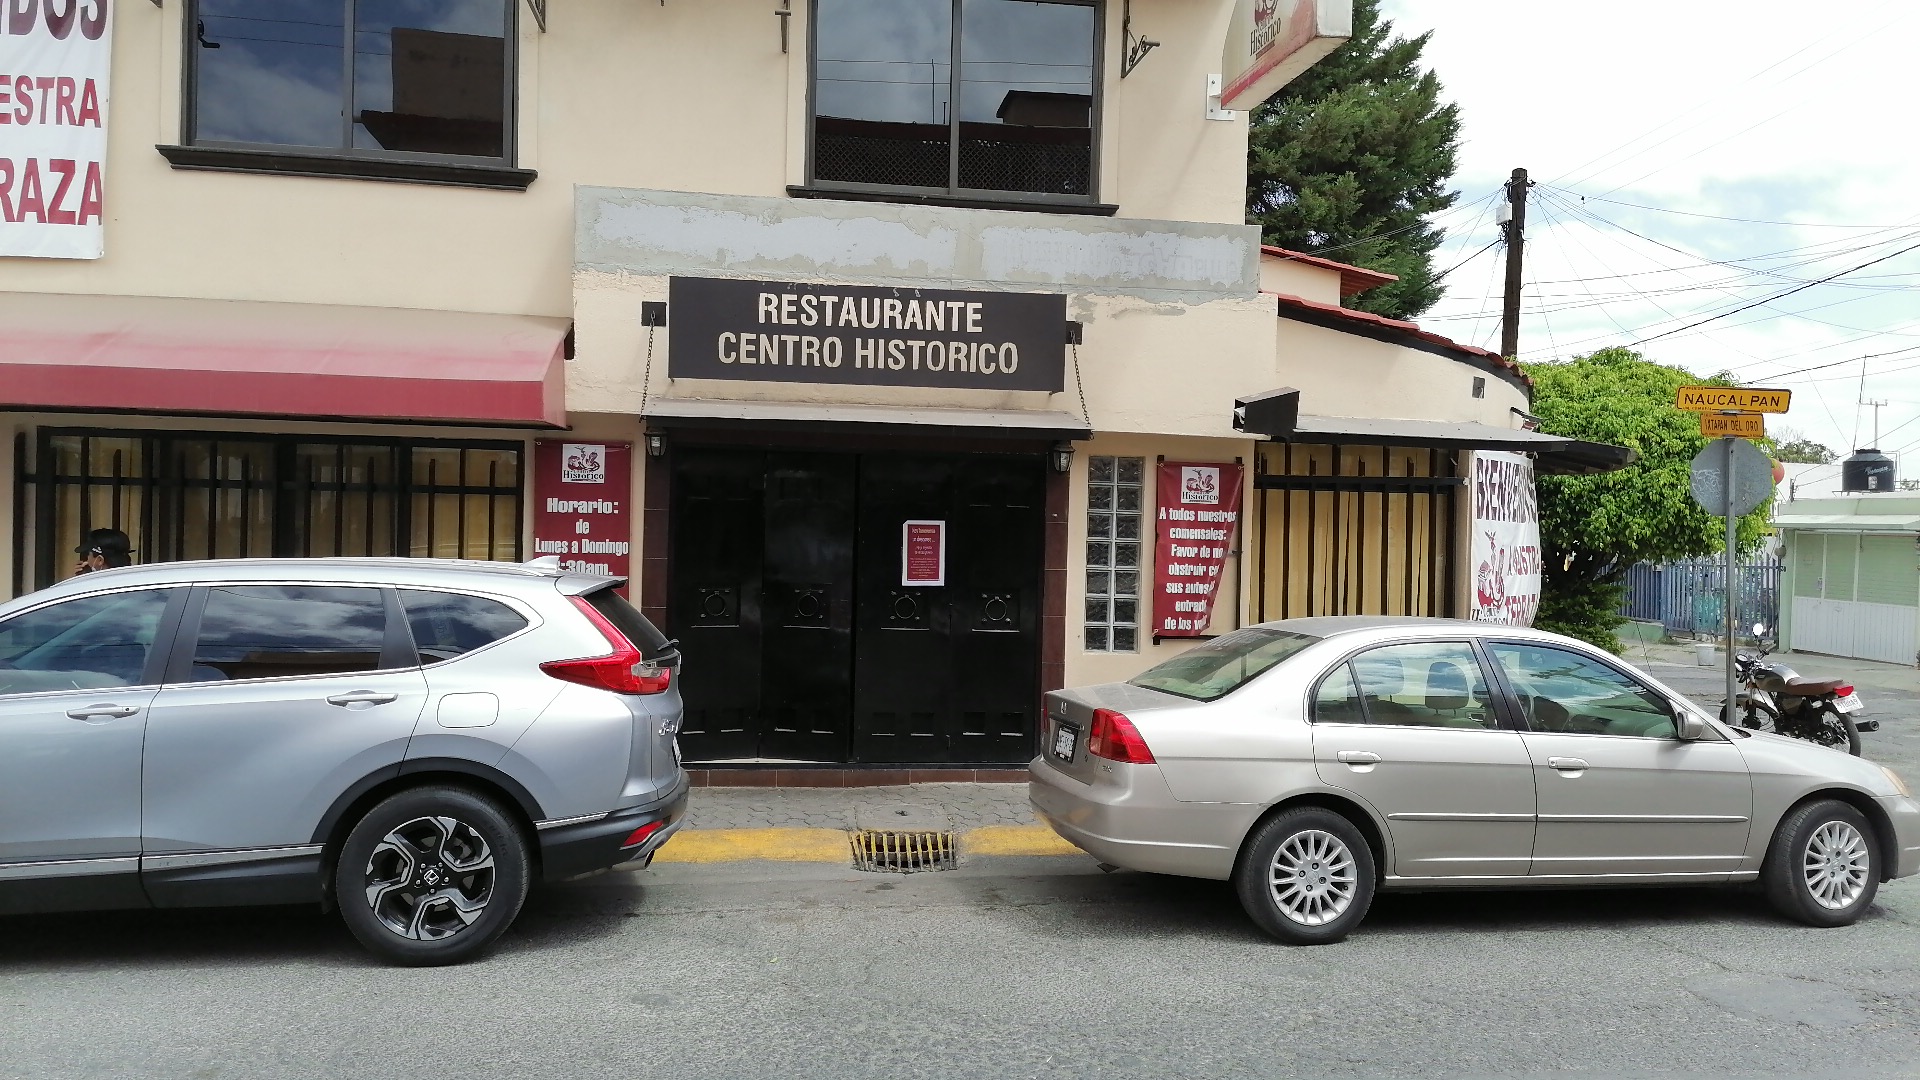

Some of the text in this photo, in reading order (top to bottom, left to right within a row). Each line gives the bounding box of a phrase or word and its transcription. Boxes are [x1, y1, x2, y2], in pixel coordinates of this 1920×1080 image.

[758, 292, 983, 333] RESTAURANTE
[718, 331, 1019, 375] CENTRO HISTORICO
[1684, 393, 1781, 407] NAUCALPAN
[1730, 419, 1743, 431] DEL
[1745, 420, 1759, 431] ORO
[546, 497, 619, 514] Horario:
[1159, 506, 1237, 523] A todos nuestros
[575, 518, 590, 534] de
[1169, 527, 1227, 540] comensales:
[535, 537, 629, 556] Lunes a Domingo
[1171, 543, 1224, 559] Favor de no
[557, 559, 614, 576] :30am.
[1168, 562, 1207, 576] obstruir
[1165, 582, 1183, 594] sus
[1184, 582, 1210, 594] autos
[1175, 599, 1207, 612] entrad
[1164, 616, 1176, 630] de
[1177, 616, 1192, 631] los
